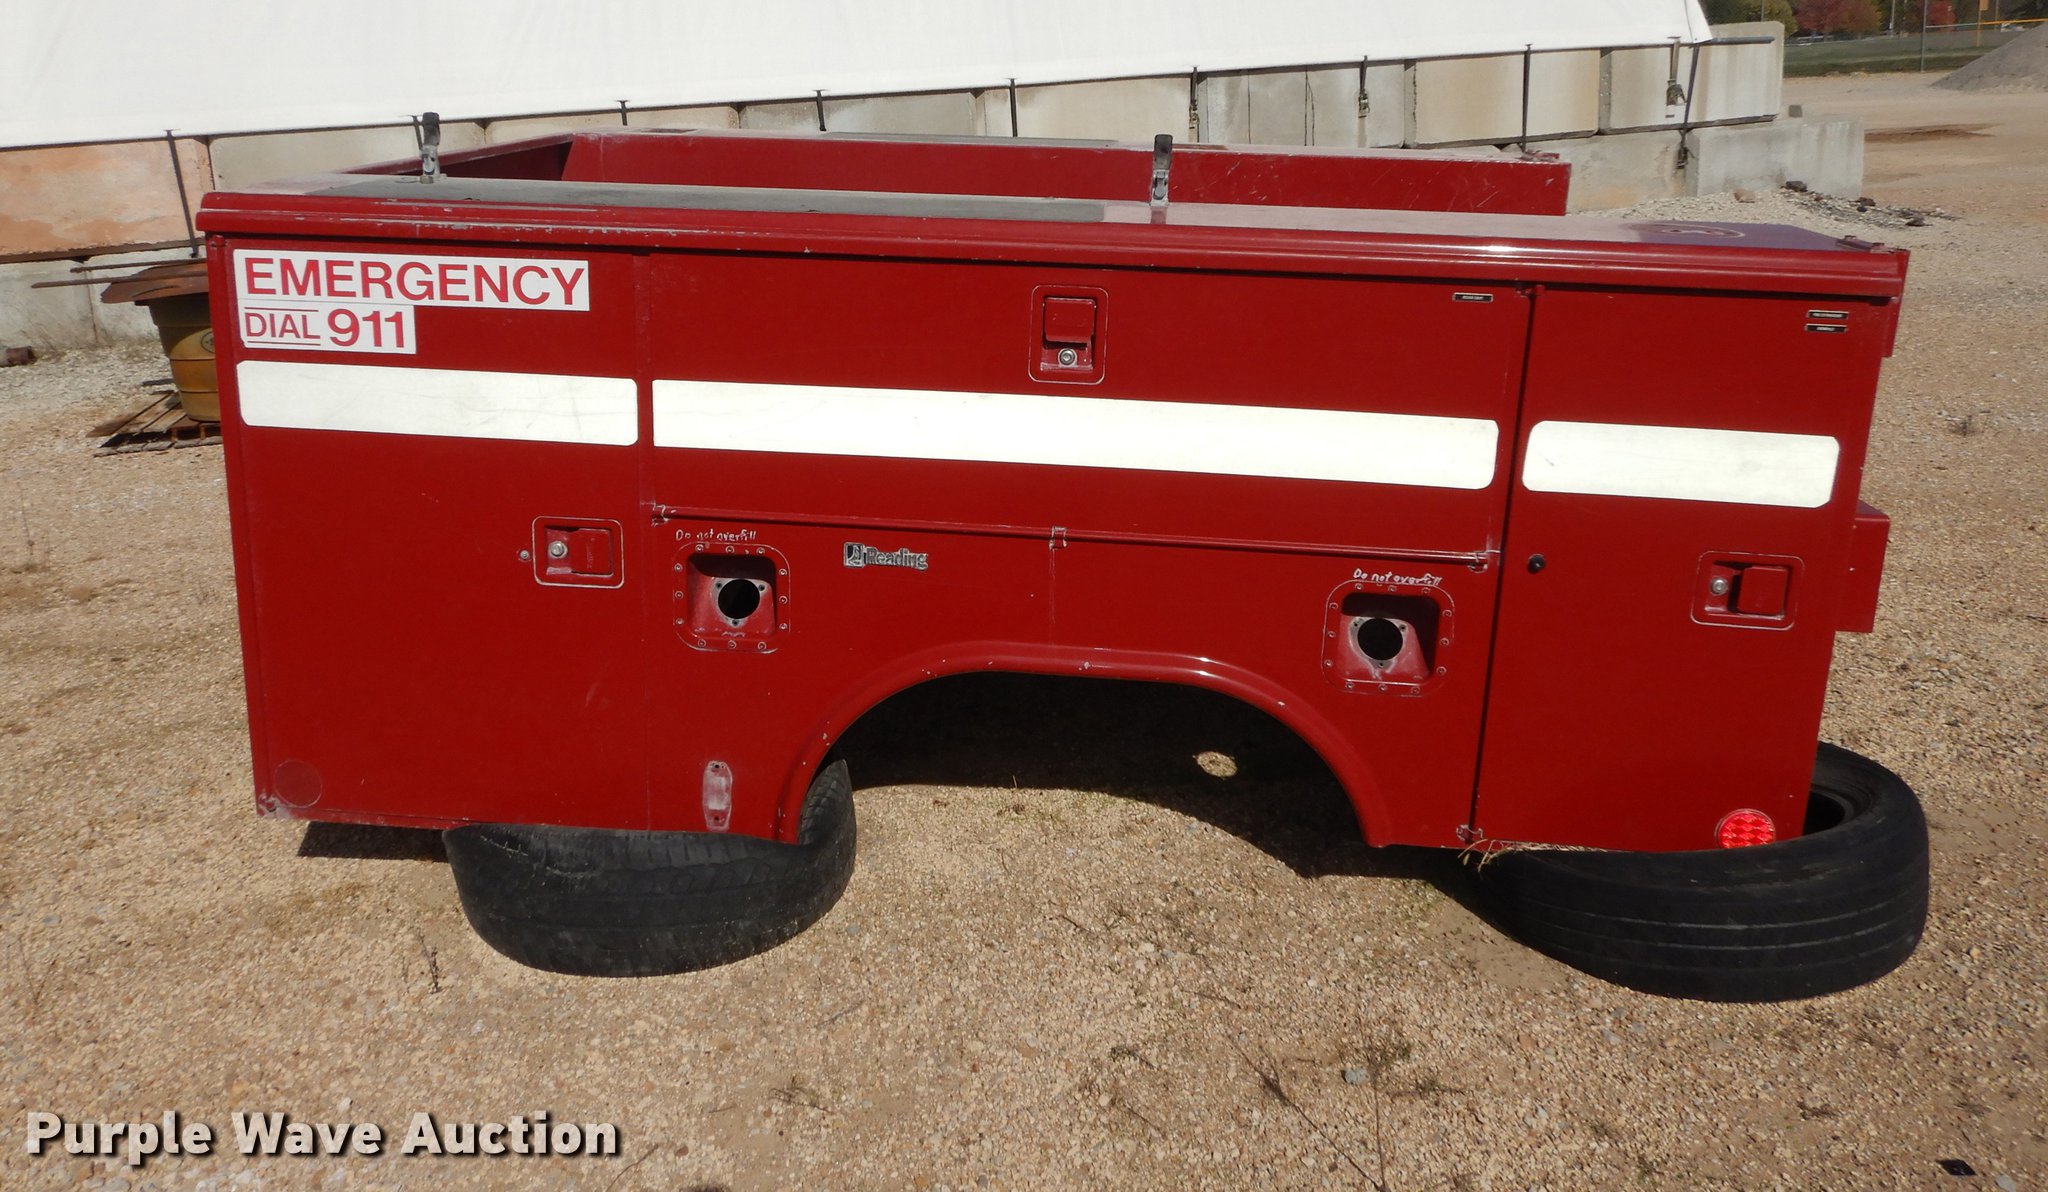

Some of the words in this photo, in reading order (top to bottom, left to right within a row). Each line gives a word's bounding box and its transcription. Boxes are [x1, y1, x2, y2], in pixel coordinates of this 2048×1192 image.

[244, 257, 585, 306] EMERGENCY
[244, 311, 321, 341] DIAL
[326, 308, 405, 349] 911
[675, 529, 692, 541] Do
[696, 528, 714, 541] not
[716, 528, 757, 542] overfill
[864, 546, 929, 571] Reading
[1353, 567, 1368, 580] Do
[1371, 571, 1393, 583] not
[1393, 573, 1443, 587] overfill
